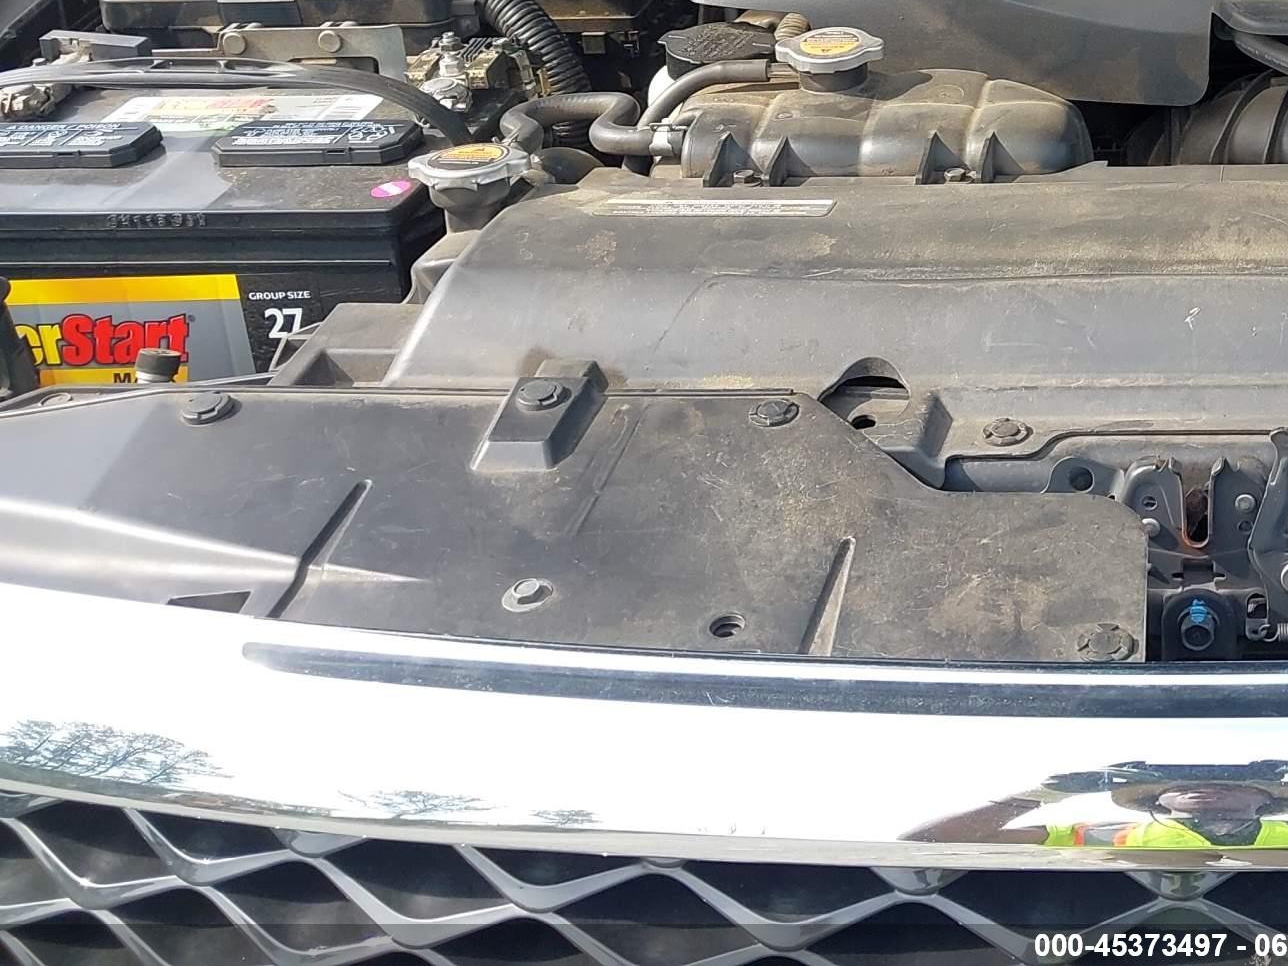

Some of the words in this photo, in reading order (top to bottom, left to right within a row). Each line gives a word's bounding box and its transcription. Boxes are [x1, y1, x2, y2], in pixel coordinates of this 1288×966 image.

[248, 291, 286, 301] GROUP
[286, 290, 311, 300] SIZE
[264, 307, 303, 339] 27
